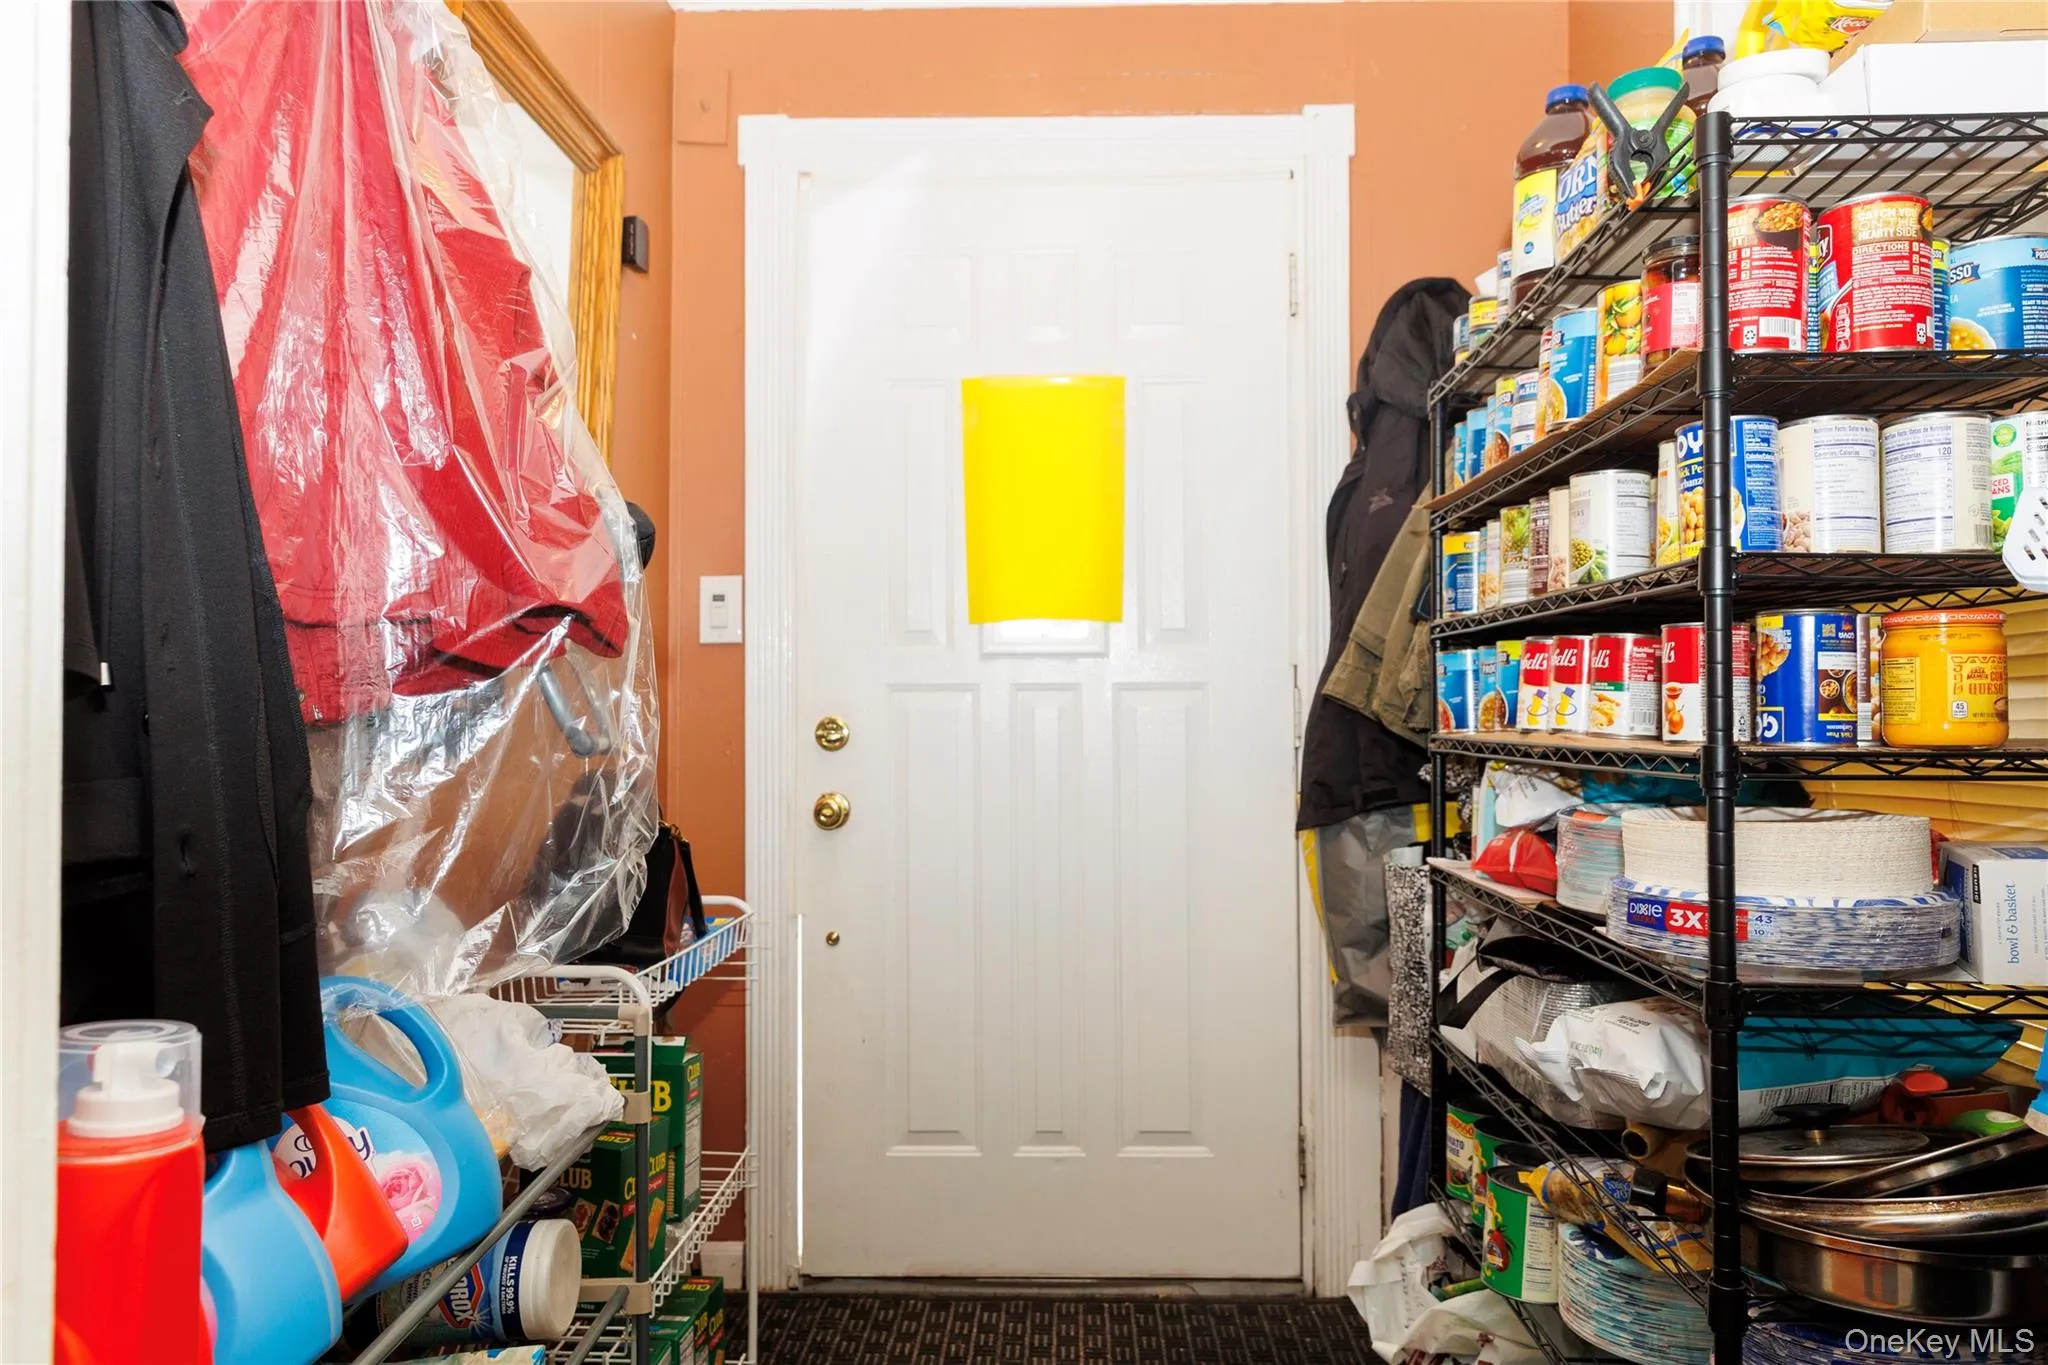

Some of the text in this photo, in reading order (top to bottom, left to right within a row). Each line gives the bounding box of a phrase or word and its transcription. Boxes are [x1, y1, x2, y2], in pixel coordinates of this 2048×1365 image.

[1852, 240, 1909, 256] DIRECTIONS
[1968, 682, 2004, 696] QUESO
[1955, 702, 1965, 710] 45
[1669, 907, 1705, 930] 3X
[1754, 914, 1773, 925] 43
[2004, 884, 2020, 964] bowl & basket
[560, 1166, 593, 1190] LUB
[506, 1255, 518, 1314] KILLS 99.9%
